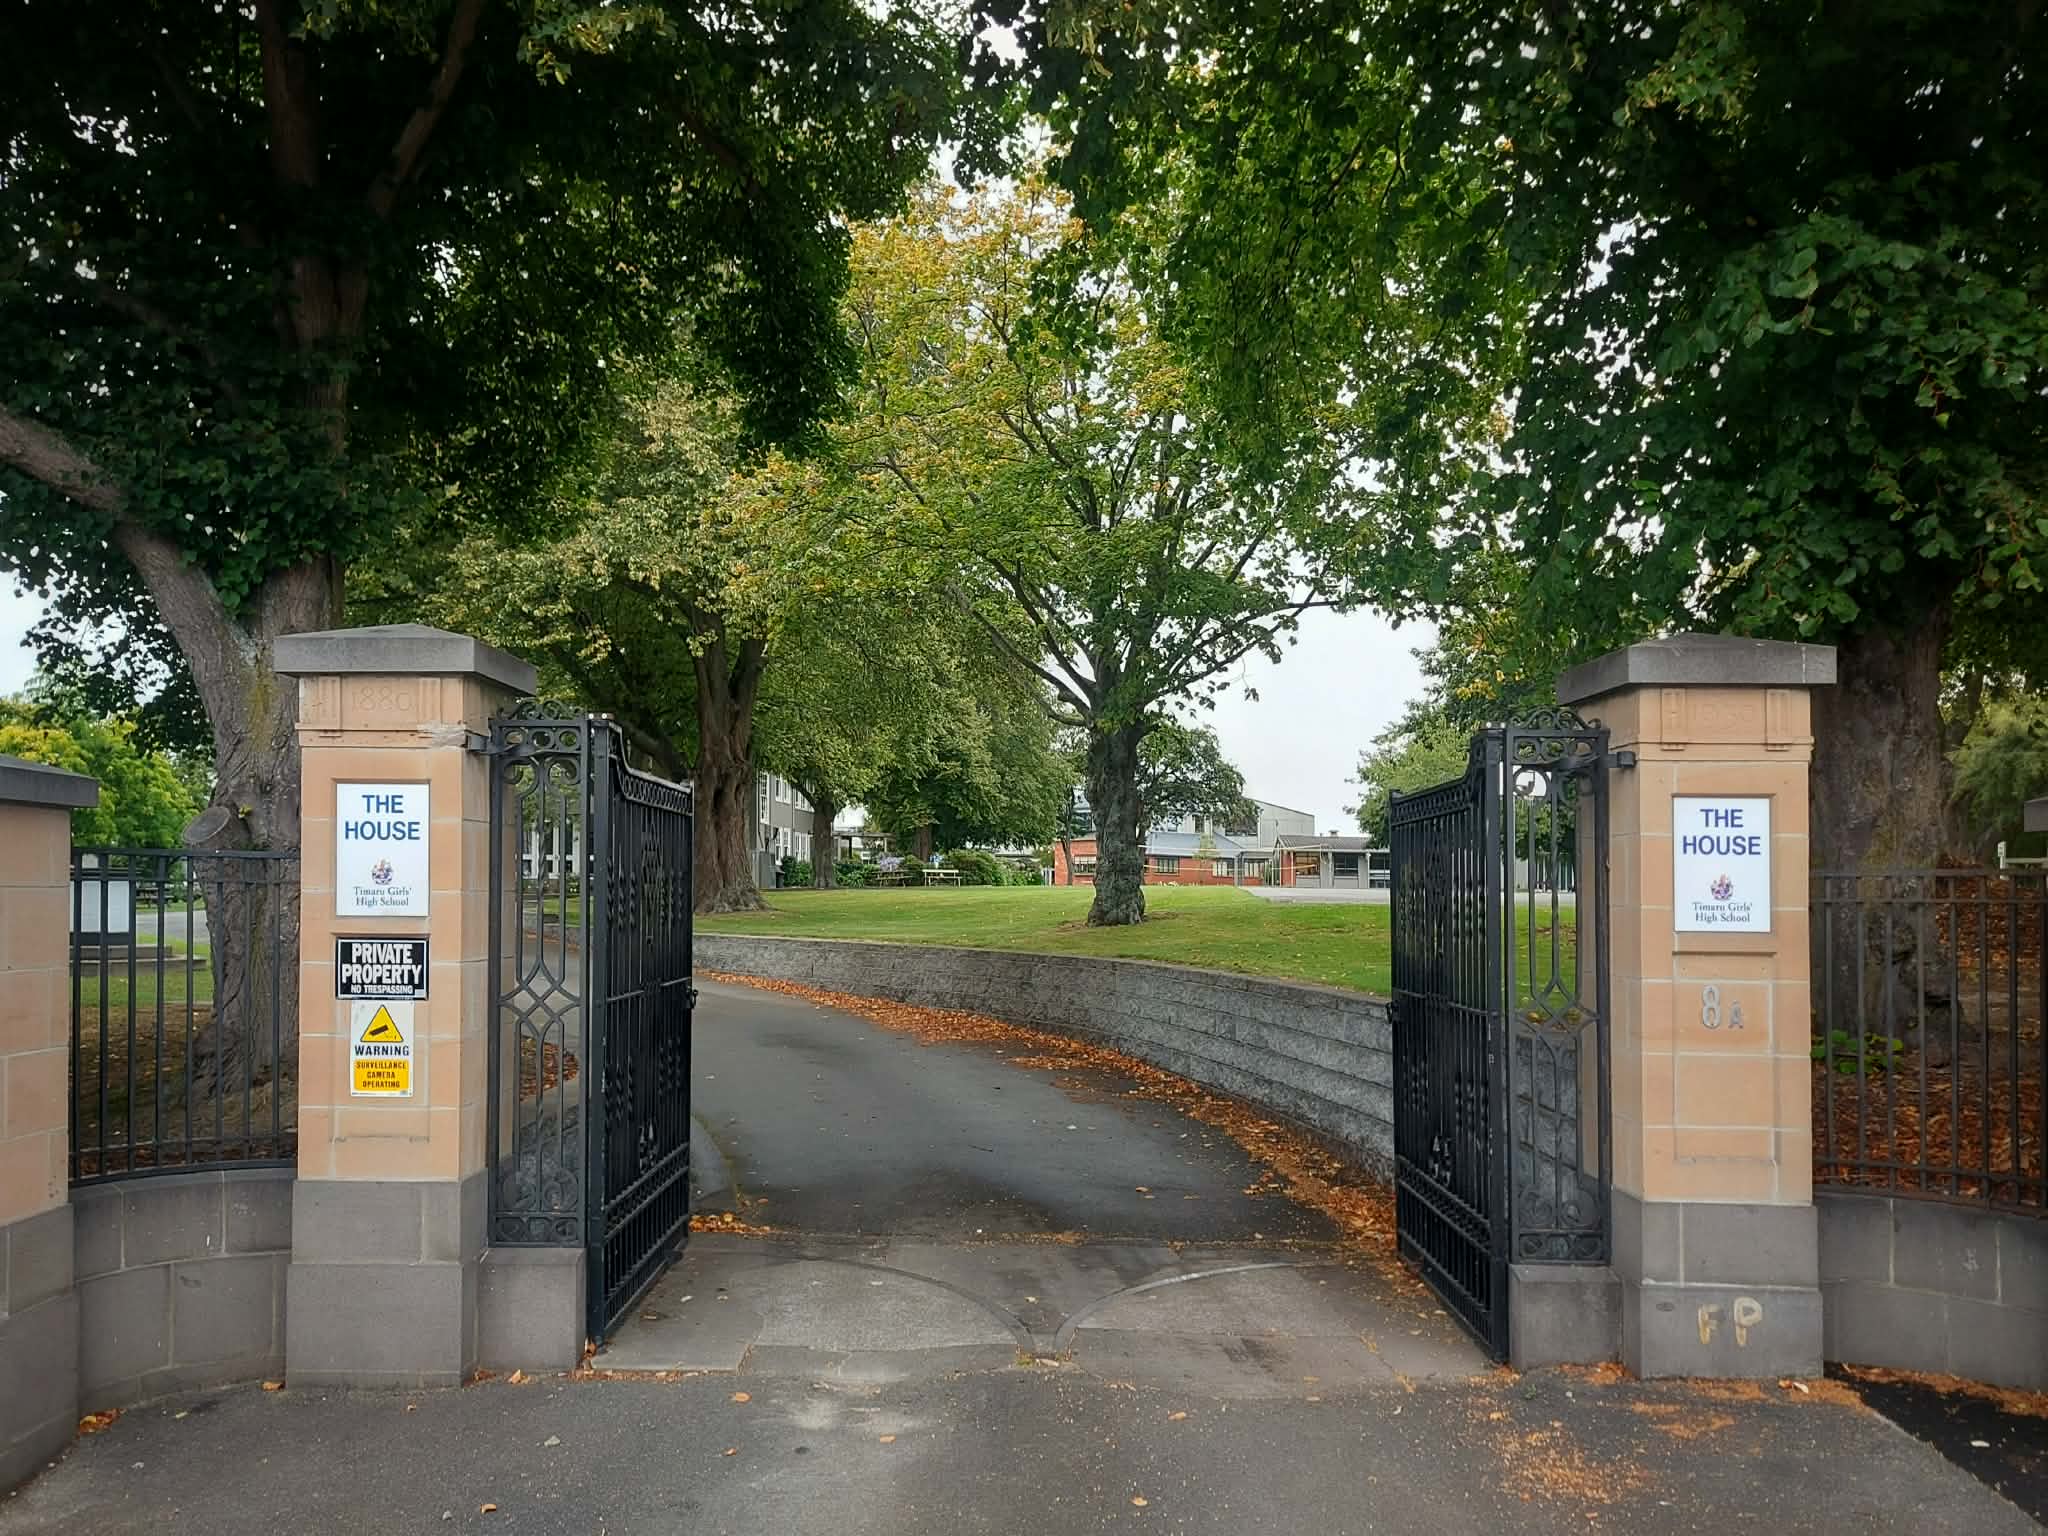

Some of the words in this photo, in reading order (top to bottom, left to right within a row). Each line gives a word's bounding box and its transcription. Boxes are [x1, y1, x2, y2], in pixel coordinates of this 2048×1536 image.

[362, 794, 404, 814] THE
[1700, 808, 1744, 828] THE
[344, 820, 421, 841] HOUSE
[1682, 835, 1761, 855] HOUSE
[353, 886, 385, 896] Timaru
[355, 897, 379, 907] High
[380, 897, 409, 906] School
[1693, 902, 1726, 912] Timaru
[1695, 912, 1718, 923] High
[1720, 912, 1750, 922] School
[352, 943, 413, 964] PRIVATE
[341, 964, 423, 985] PROPERTY
[351, 984, 362, 994] NO
[364, 984, 413, 994] TRESPASSING
[354, 1045, 410, 1056] WARNING
[355, 1061, 407, 1070] SURVEILLANCE
[366, 1071, 396, 1079] CAMERA
[362, 1080, 400, 1089] OPERATING
